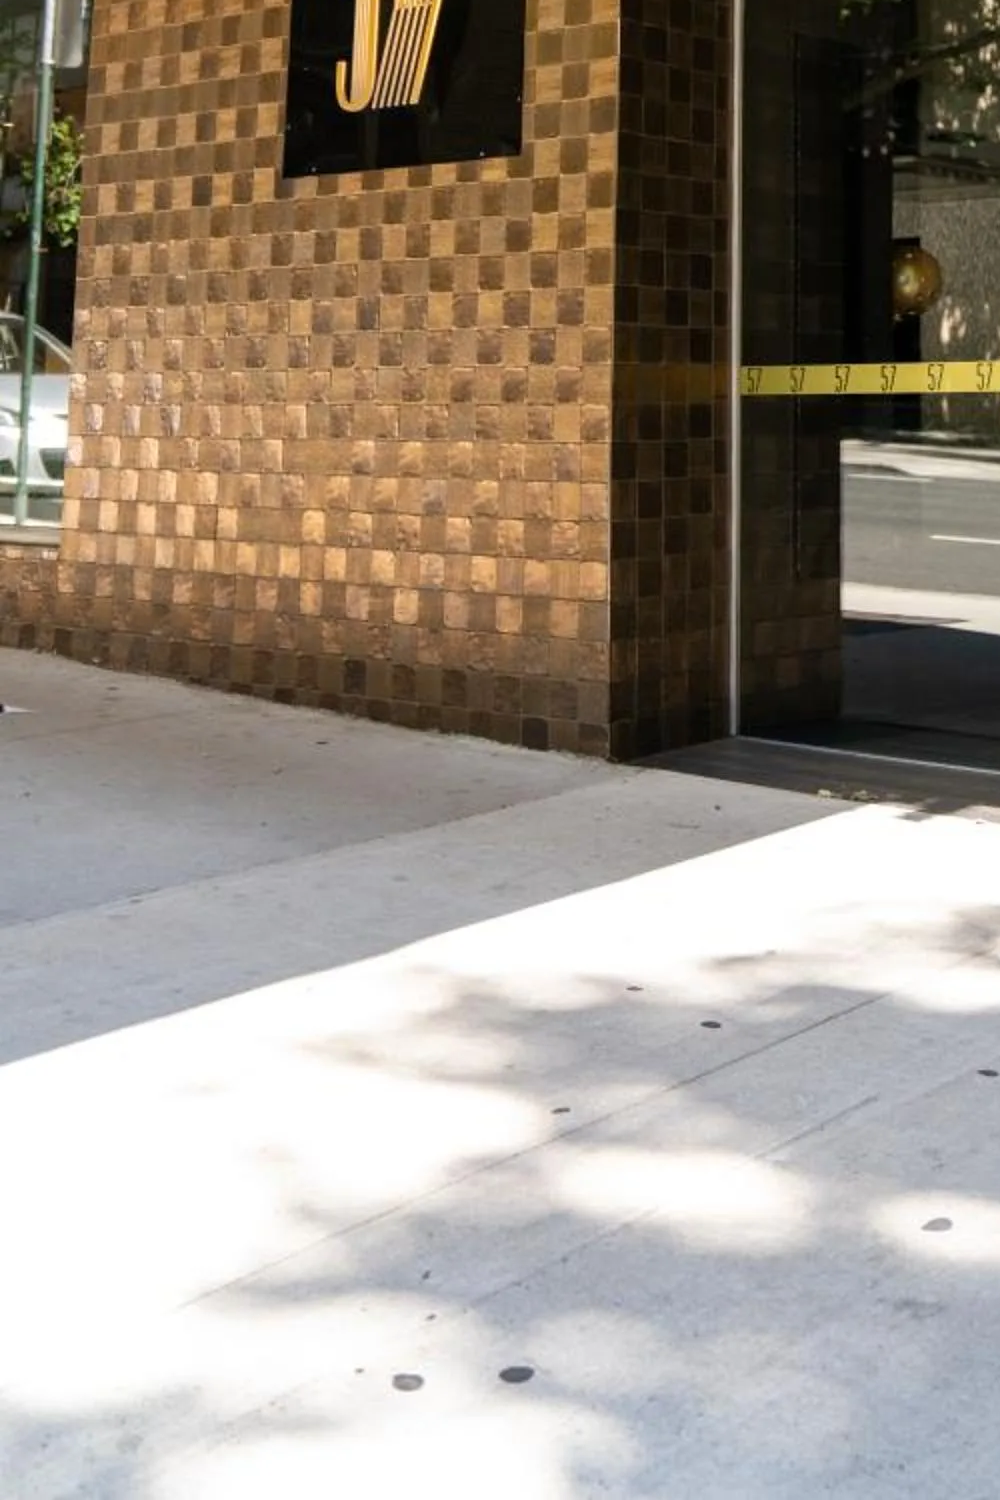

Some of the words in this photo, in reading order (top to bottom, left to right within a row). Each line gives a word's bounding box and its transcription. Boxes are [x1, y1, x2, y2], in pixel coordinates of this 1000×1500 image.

[747, 368, 762, 392] 57
[789, 367, 806, 392] 57
[834, 366, 850, 392] 57
[880, 365, 896, 392] 57
[928, 364, 944, 391] 57
[976, 362, 992, 390] 57
